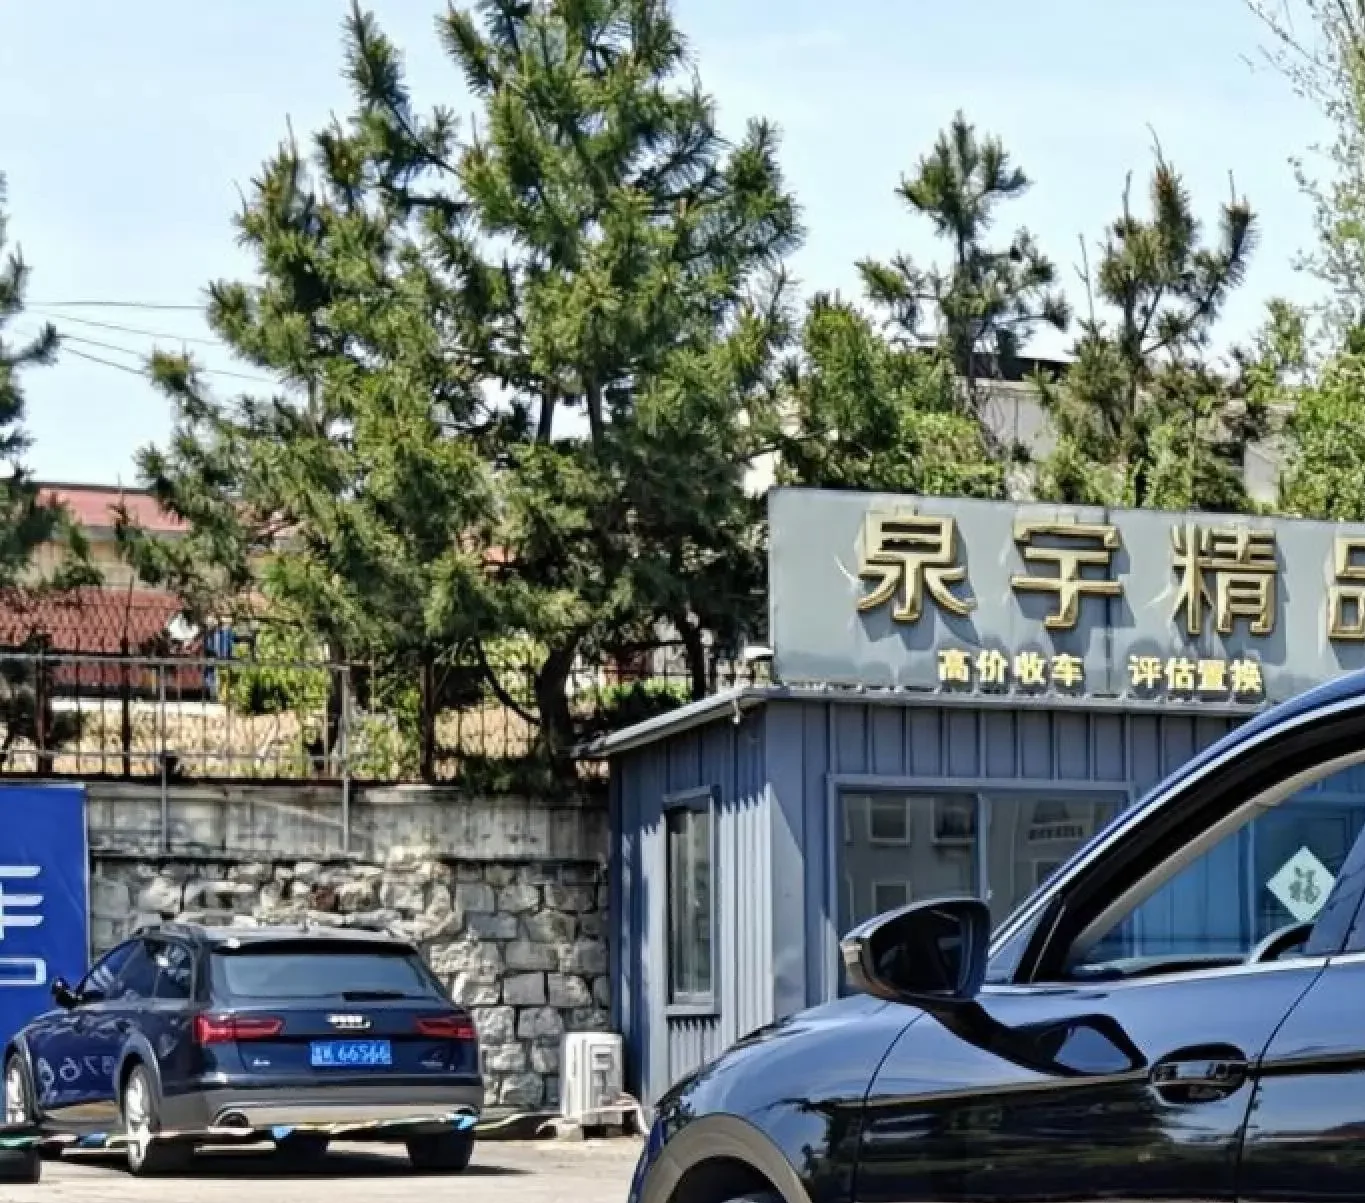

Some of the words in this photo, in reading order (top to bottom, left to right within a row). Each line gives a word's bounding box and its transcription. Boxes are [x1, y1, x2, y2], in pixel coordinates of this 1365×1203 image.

[938, 648, 1083, 688] 高价收车
[1128, 655, 1262, 693] 评估置换
